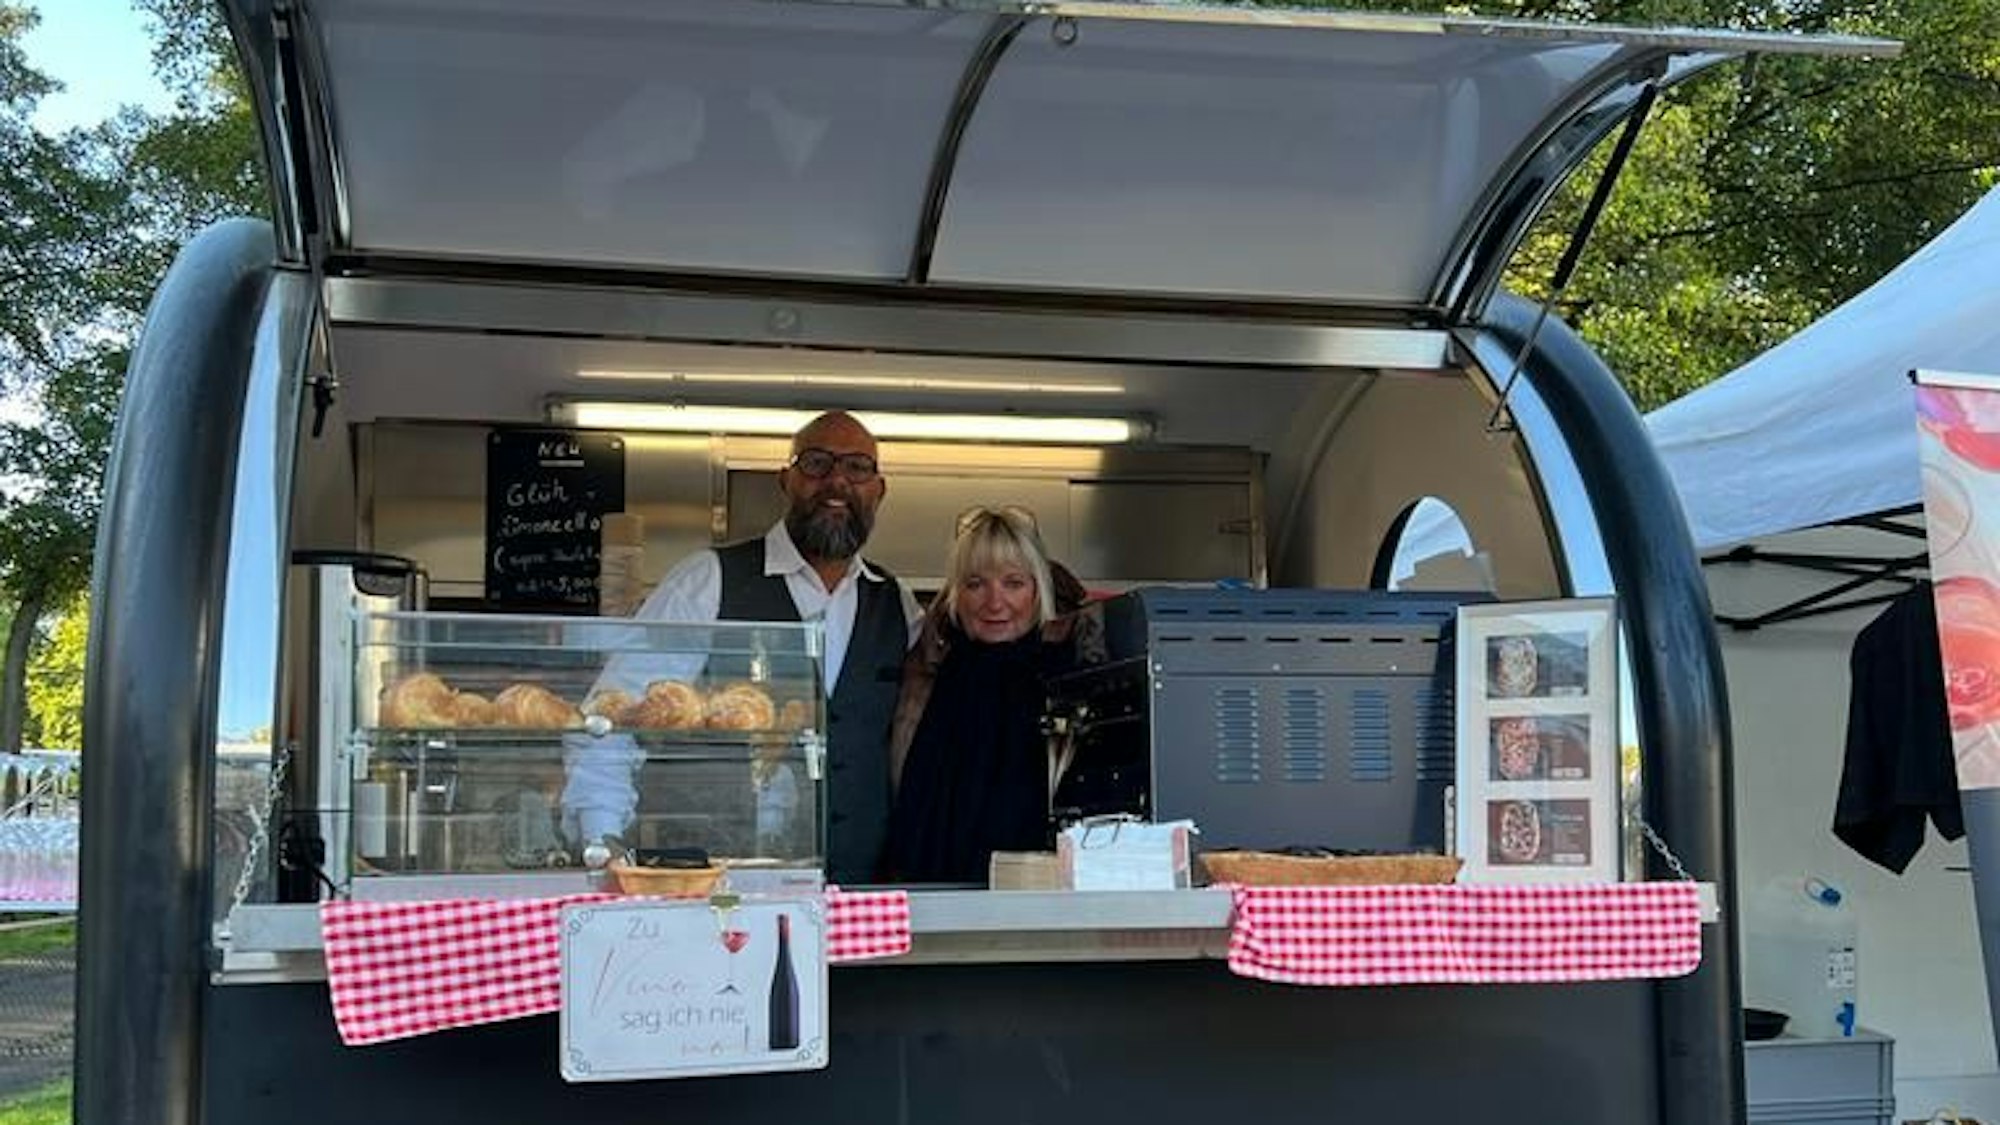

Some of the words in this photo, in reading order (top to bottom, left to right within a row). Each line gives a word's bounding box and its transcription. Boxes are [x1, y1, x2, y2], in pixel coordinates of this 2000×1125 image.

[538, 441, 581, 457] NEU
[626, 915, 661, 941] Zu
[620, 1009, 661, 1035] sag
[667, 1004, 702, 1027] ich
[709, 1005, 745, 1025] nie
